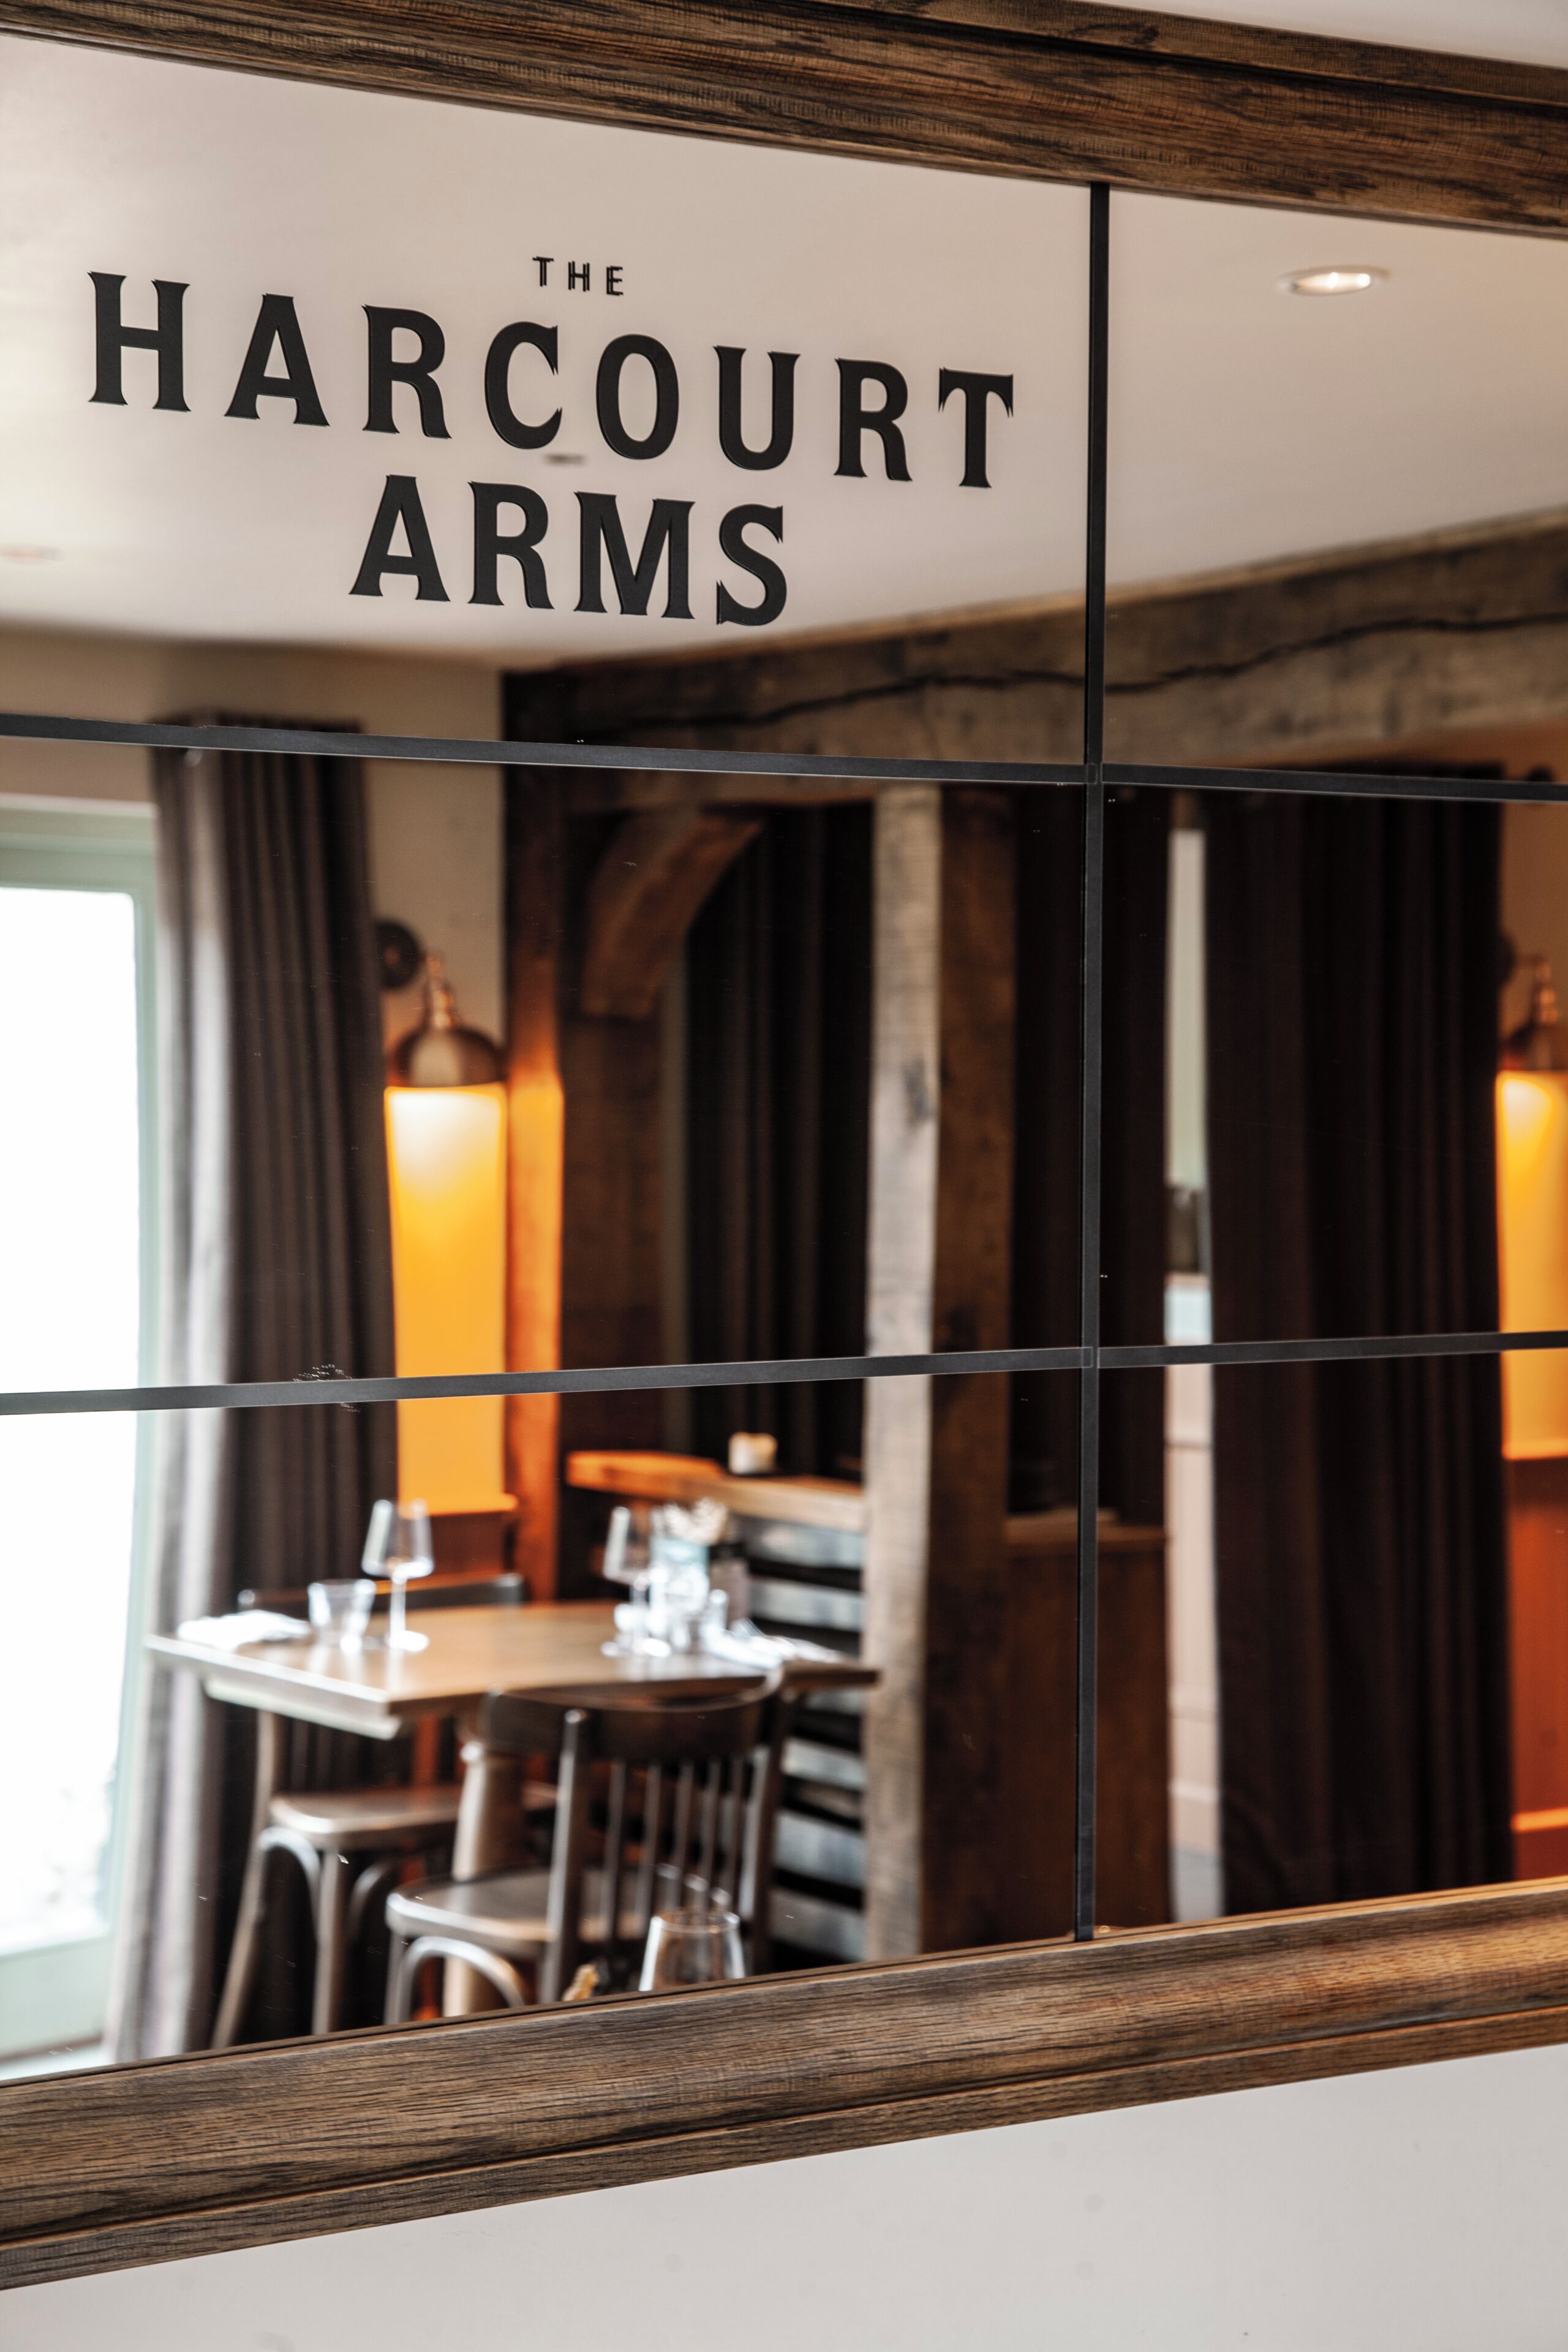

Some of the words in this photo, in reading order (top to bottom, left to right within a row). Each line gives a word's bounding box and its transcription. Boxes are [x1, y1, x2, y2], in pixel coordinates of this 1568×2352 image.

[532, 255, 624, 297] THE
[87, 271, 1014, 489] HARCOURT
[348, 473, 788, 627] ARMS
